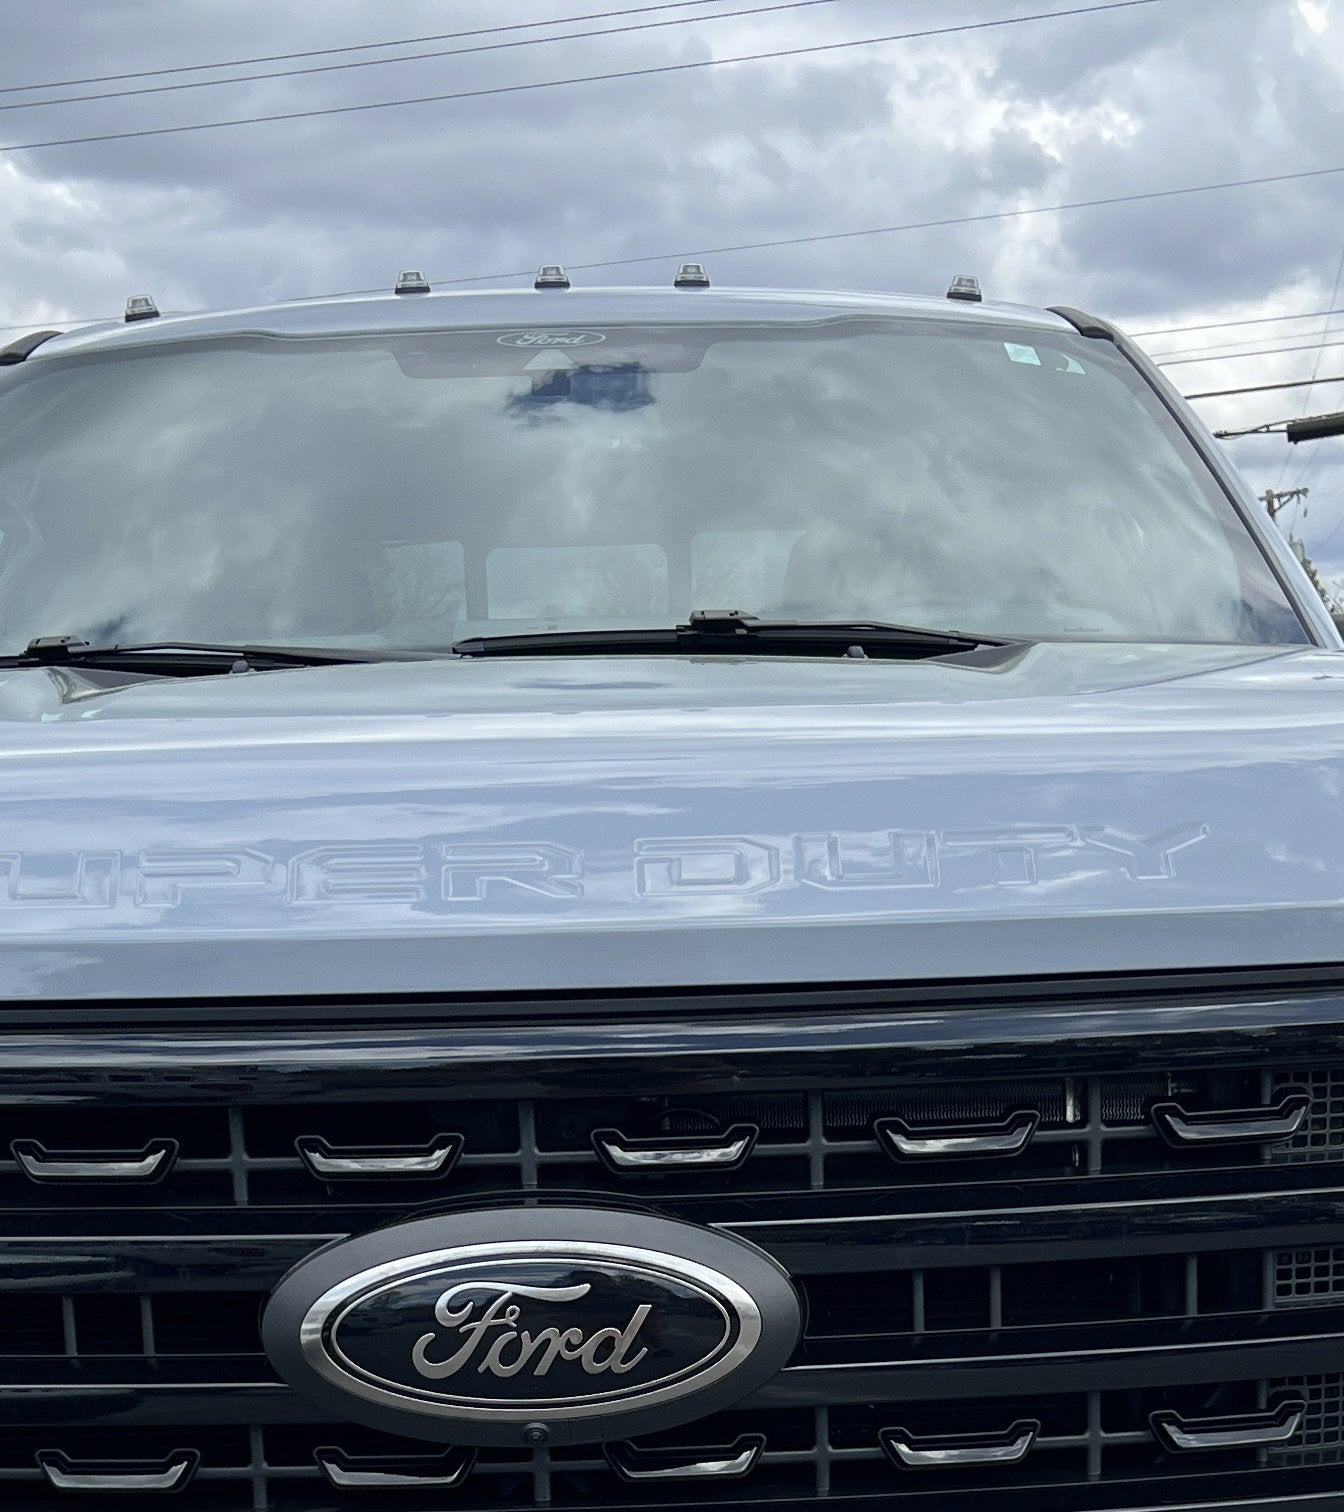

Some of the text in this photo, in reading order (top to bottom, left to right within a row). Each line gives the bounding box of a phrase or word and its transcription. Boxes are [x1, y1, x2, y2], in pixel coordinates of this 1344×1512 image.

[516, 331, 587, 345] Ford
[633, 822, 1213, 897] DUTY
[411, 1280, 653, 1380] Ford
